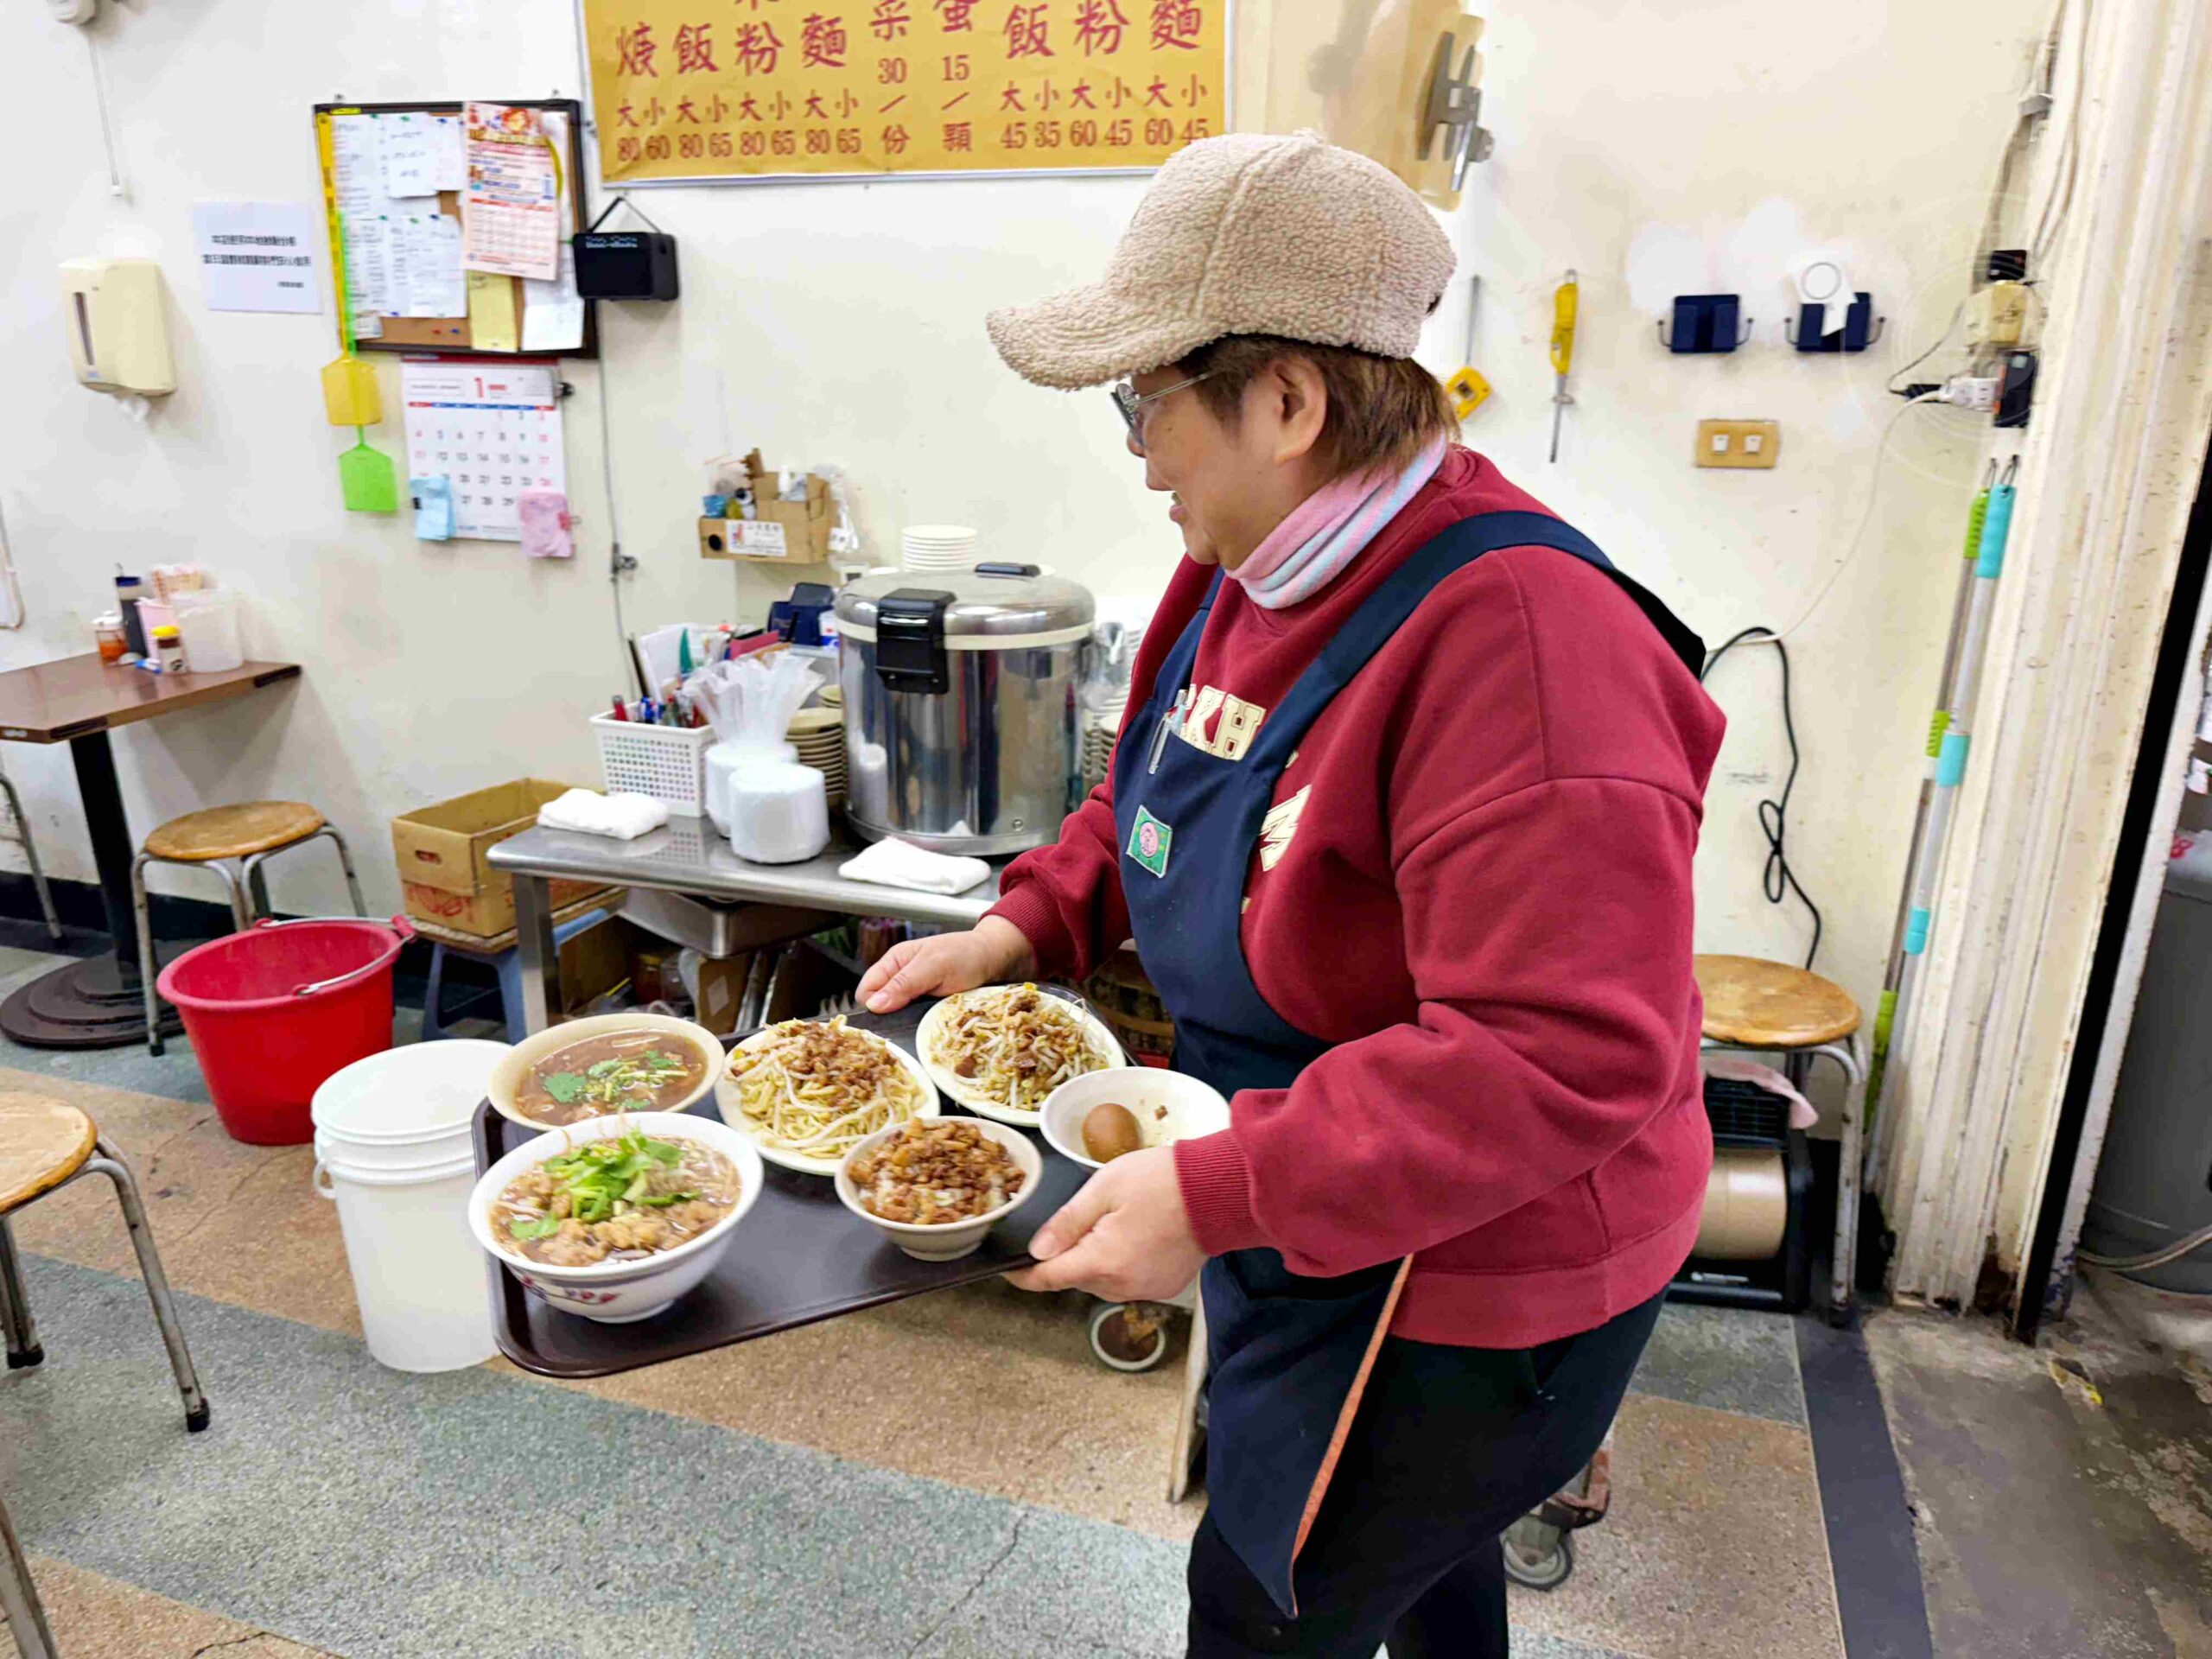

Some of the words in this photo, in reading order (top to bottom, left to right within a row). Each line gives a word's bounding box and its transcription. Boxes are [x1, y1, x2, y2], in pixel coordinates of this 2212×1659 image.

[1002, 4, 1055, 59] 飯
[1074, 0, 1130, 57] 粉
[1150, 0, 1199, 51] 麵
[672, 22, 719, 74] 飯
[734, 21, 785, 76] 粉
[800, 12, 846, 68] 麵
[877, 57, 907, 84] 30
[942, 54, 970, 81] 15
[678, 133, 704, 159] 80
[709, 132, 734, 157] 65
[740, 130, 766, 156] 80
[771, 130, 796, 156] 65
[804, 129, 830, 155] 80
[836, 128, 861, 154] 65
[1000, 122, 1027, 149] 45
[1034, 121, 1061, 148] 35
[1069, 119, 1097, 147] 60
[1105, 118, 1133, 147] 45
[1144, 118, 1174, 146] 60
[617, 137, 640, 162] 80
[645, 135, 671, 161] 60
